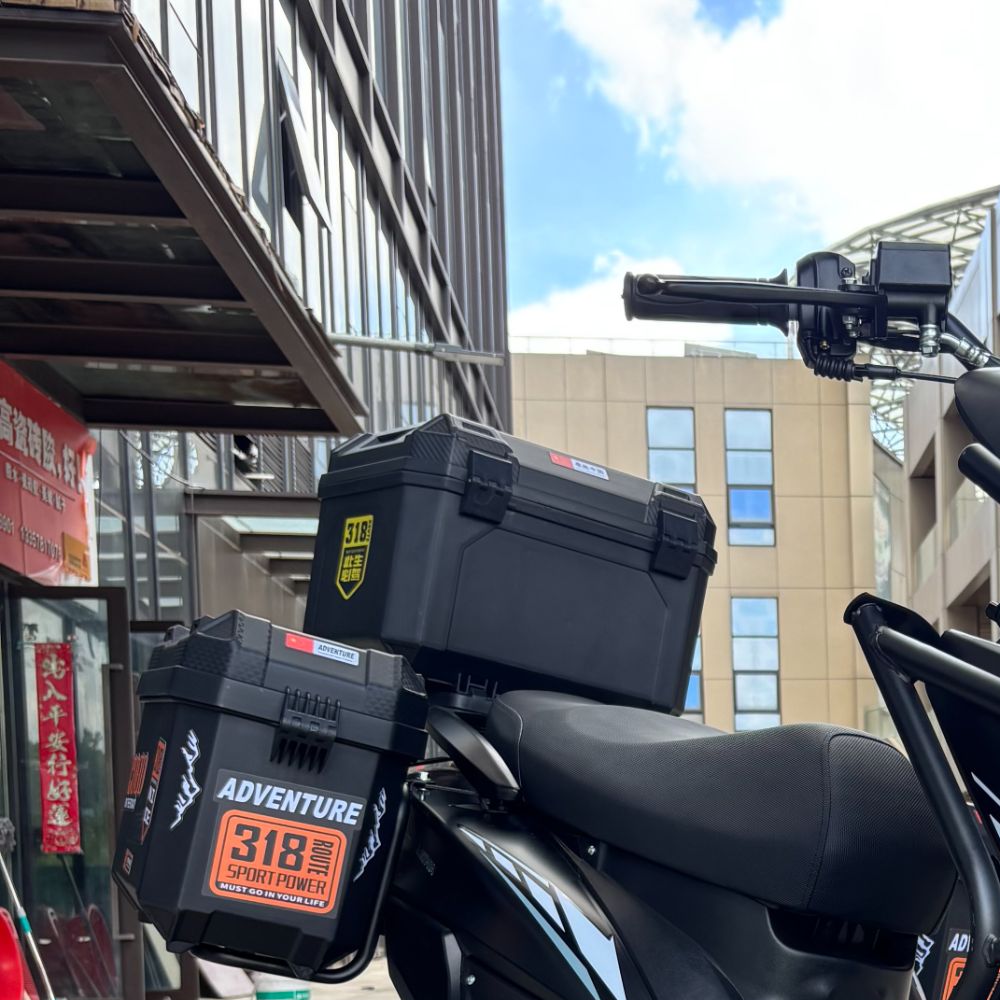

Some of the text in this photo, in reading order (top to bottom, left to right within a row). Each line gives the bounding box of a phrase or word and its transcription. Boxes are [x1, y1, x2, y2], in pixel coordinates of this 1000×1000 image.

[345, 520, 368, 545] 318
[317, 644, 355, 660] ADVENTURE
[217, 777, 363, 826] ADVENTURE
[230, 823, 308, 872] 318
[307, 838, 334, 877] ROUTE
[220, 882, 326, 909] MUST GO IN YOUR LIFE
[226, 864, 327, 896] SPORT POWER
